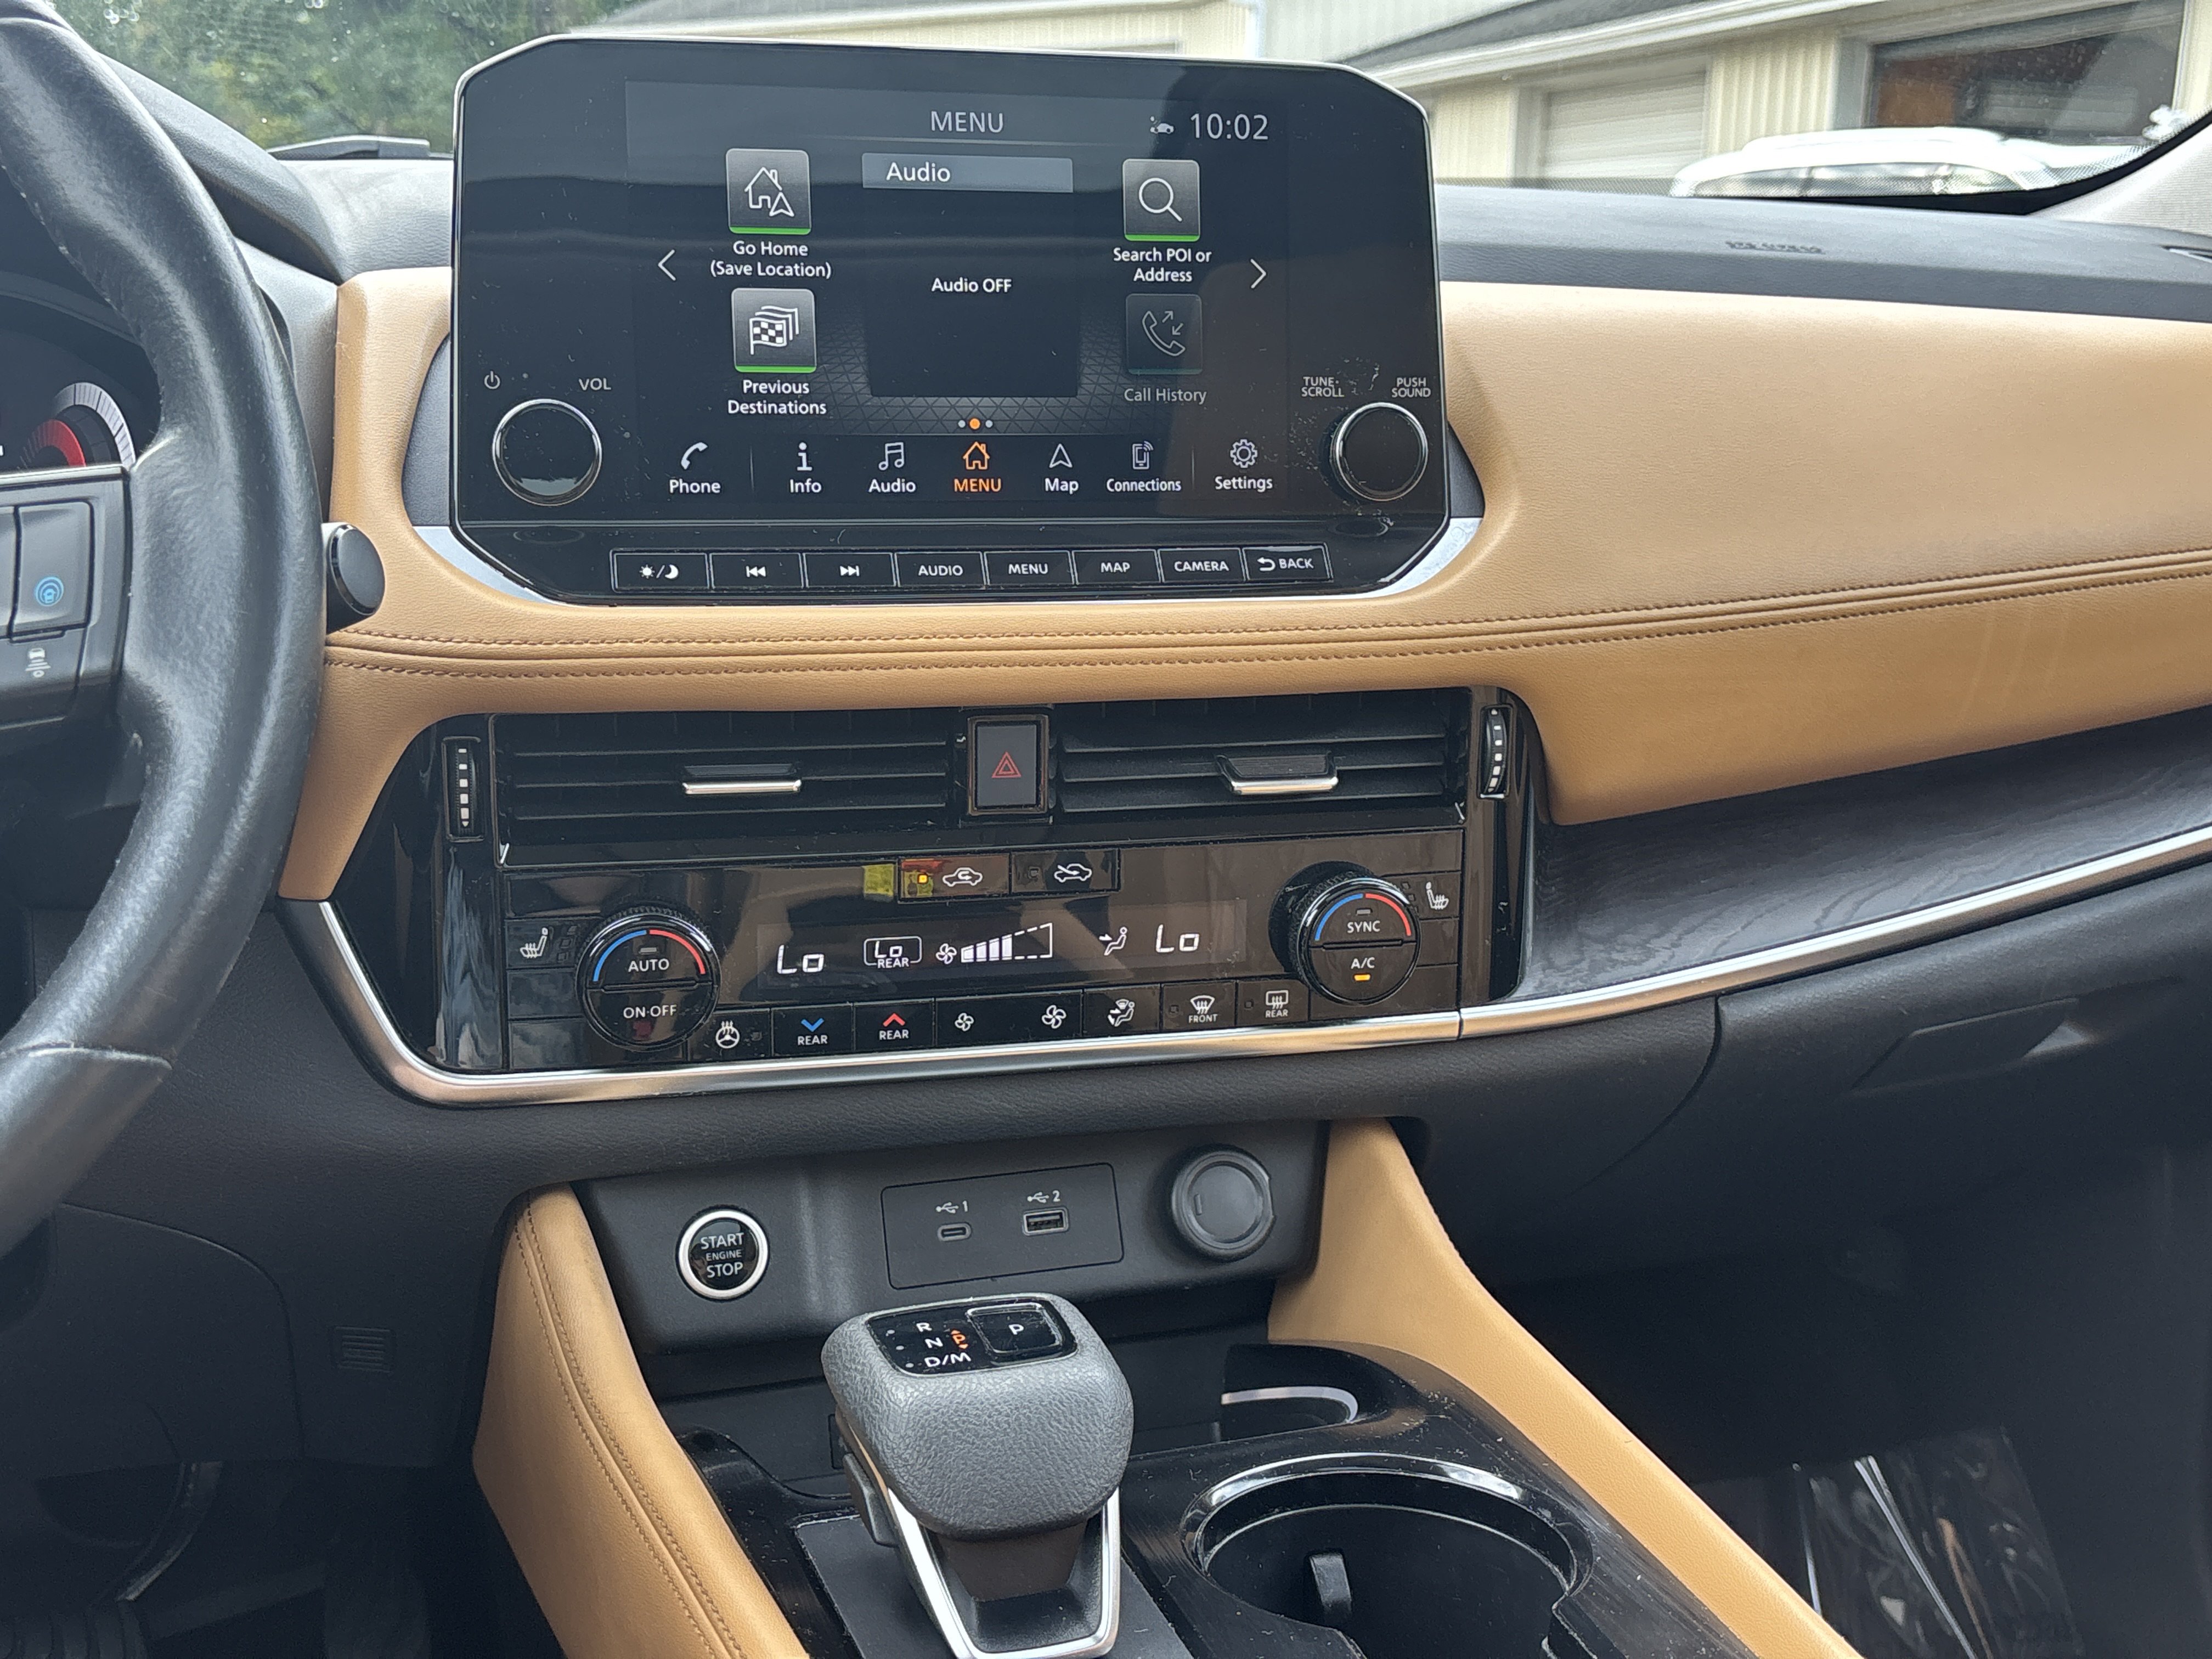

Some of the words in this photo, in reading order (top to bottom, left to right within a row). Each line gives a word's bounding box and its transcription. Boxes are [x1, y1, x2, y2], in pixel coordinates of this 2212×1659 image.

[931, 111, 1003, 133] MENU
[1190, 113, 1268, 140] 10:02
[886, 161, 951, 182] Audio
[733, 240, 756, 255] Go
[760, 241, 808, 256] Home
[1113, 247, 1162, 262] Search
[1166, 248, 1192, 262] POI
[1195, 251, 1212, 262] or
[710, 259, 753, 278] (Save
[757, 262, 831, 279] Location)
[1133, 267, 1192, 282] Address
[931, 276, 979, 292] Audio
[983, 278, 1012, 292] OFF
[578, 377, 612, 391] VOL
[743, 379, 810, 394] Previous
[1396, 377, 1426, 388] PUSH
[1124, 387, 1151, 402] Call
[1156, 388, 1207, 405] History
[1301, 386, 1344, 397] SCROLL
[1391, 387, 1431, 398] SOUND
[728, 399, 827, 414] Destinations
[669, 478, 721, 493] Phone
[790, 478, 822, 493] Info
[868, 478, 916, 493] Audio
[954, 478, 1001, 492] MENU
[1045, 478, 1079, 494] Map
[1107, 478, 1182, 492] Connections
[1215, 476, 1273, 493] Settings
[1008, 563, 1048, 574] MENU
[1101, 562, 1130, 573] MAP
[1174, 561, 1229, 572] CAMERA
[1278, 557, 1314, 569] BACK
[918, 565, 963, 576] AUDIO
[1347, 920, 1380, 933] SYNC
[628, 958, 669, 972] AUTO
[877, 957, 909, 968] REAR
[1351, 957, 1375, 969] A/C
[1188, 1013, 1218, 1023] FRONT
[1265, 1009, 1289, 1018] REAR
[797, 1035, 828, 1046] REAR
[879, 1029, 909, 1040] REAR
[1052, 1190, 1060, 1202] 2
[962, 1200, 968, 1212] 1
[700, 1232, 744, 1249] START
[706, 1249, 742, 1261] ENGINE
[706, 1261, 743, 1278] STOP
[916, 1322, 932, 1333] R
[1008, 1324, 1024, 1335] P
[924, 1337, 943, 1348] N
[924, 1352, 972, 1368] D/M
